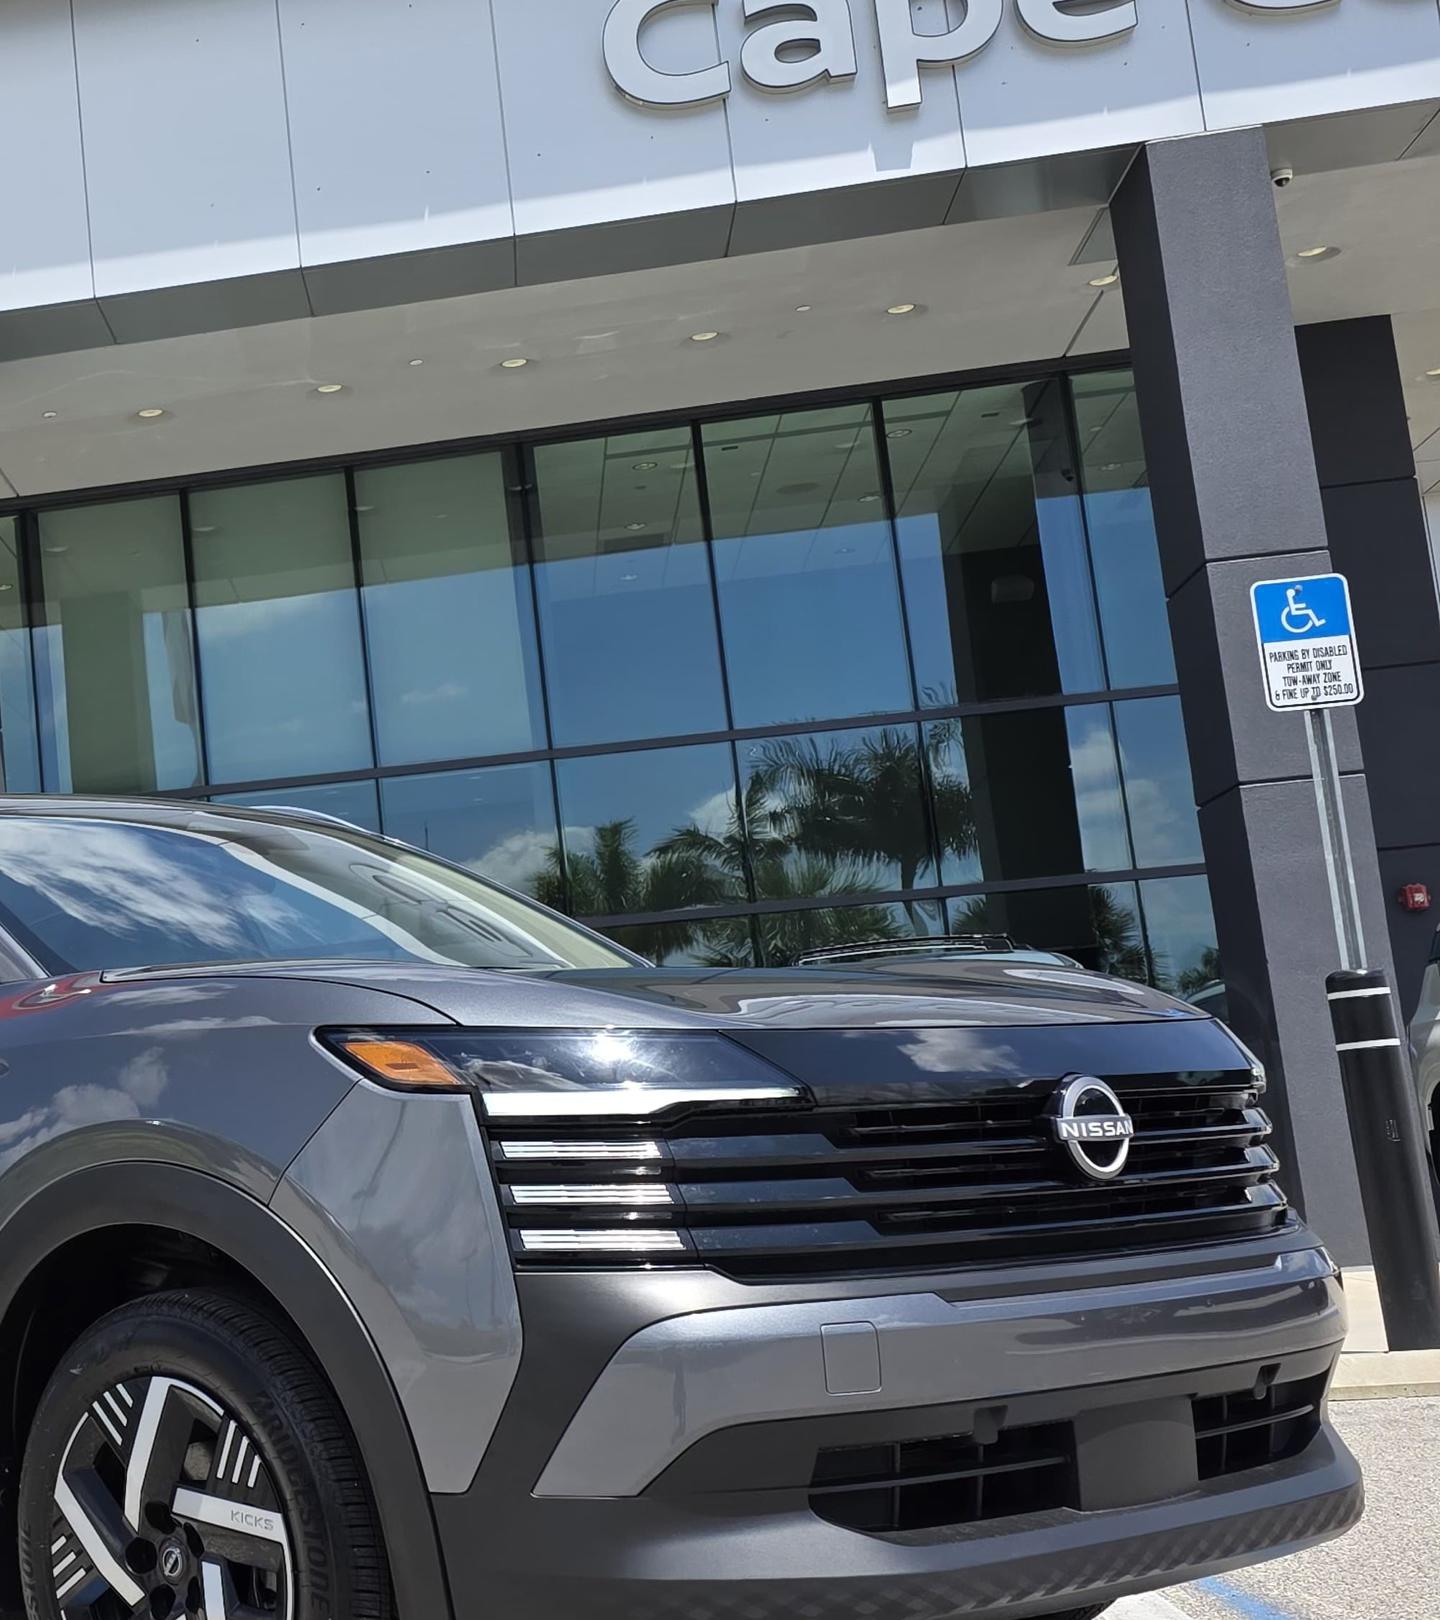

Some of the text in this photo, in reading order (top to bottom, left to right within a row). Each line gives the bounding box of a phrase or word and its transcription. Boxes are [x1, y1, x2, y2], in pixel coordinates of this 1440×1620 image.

[1269, 645, 1348, 663] PARKING BY DISABLED
[1287, 660, 1332, 673] PERMIT ONLY
[1282, 672, 1342, 687] TOW-AWAY ZONE
[1282, 688, 1298, 700] FINE
[1300, 687, 1310, 699] UP
[1311, 686, 1321, 697] TO
[1323, 683, 1354, 696] $250.00
[1061, 1120, 1134, 1137] NISSAN
[230, 1509, 275, 1531] KICKS
